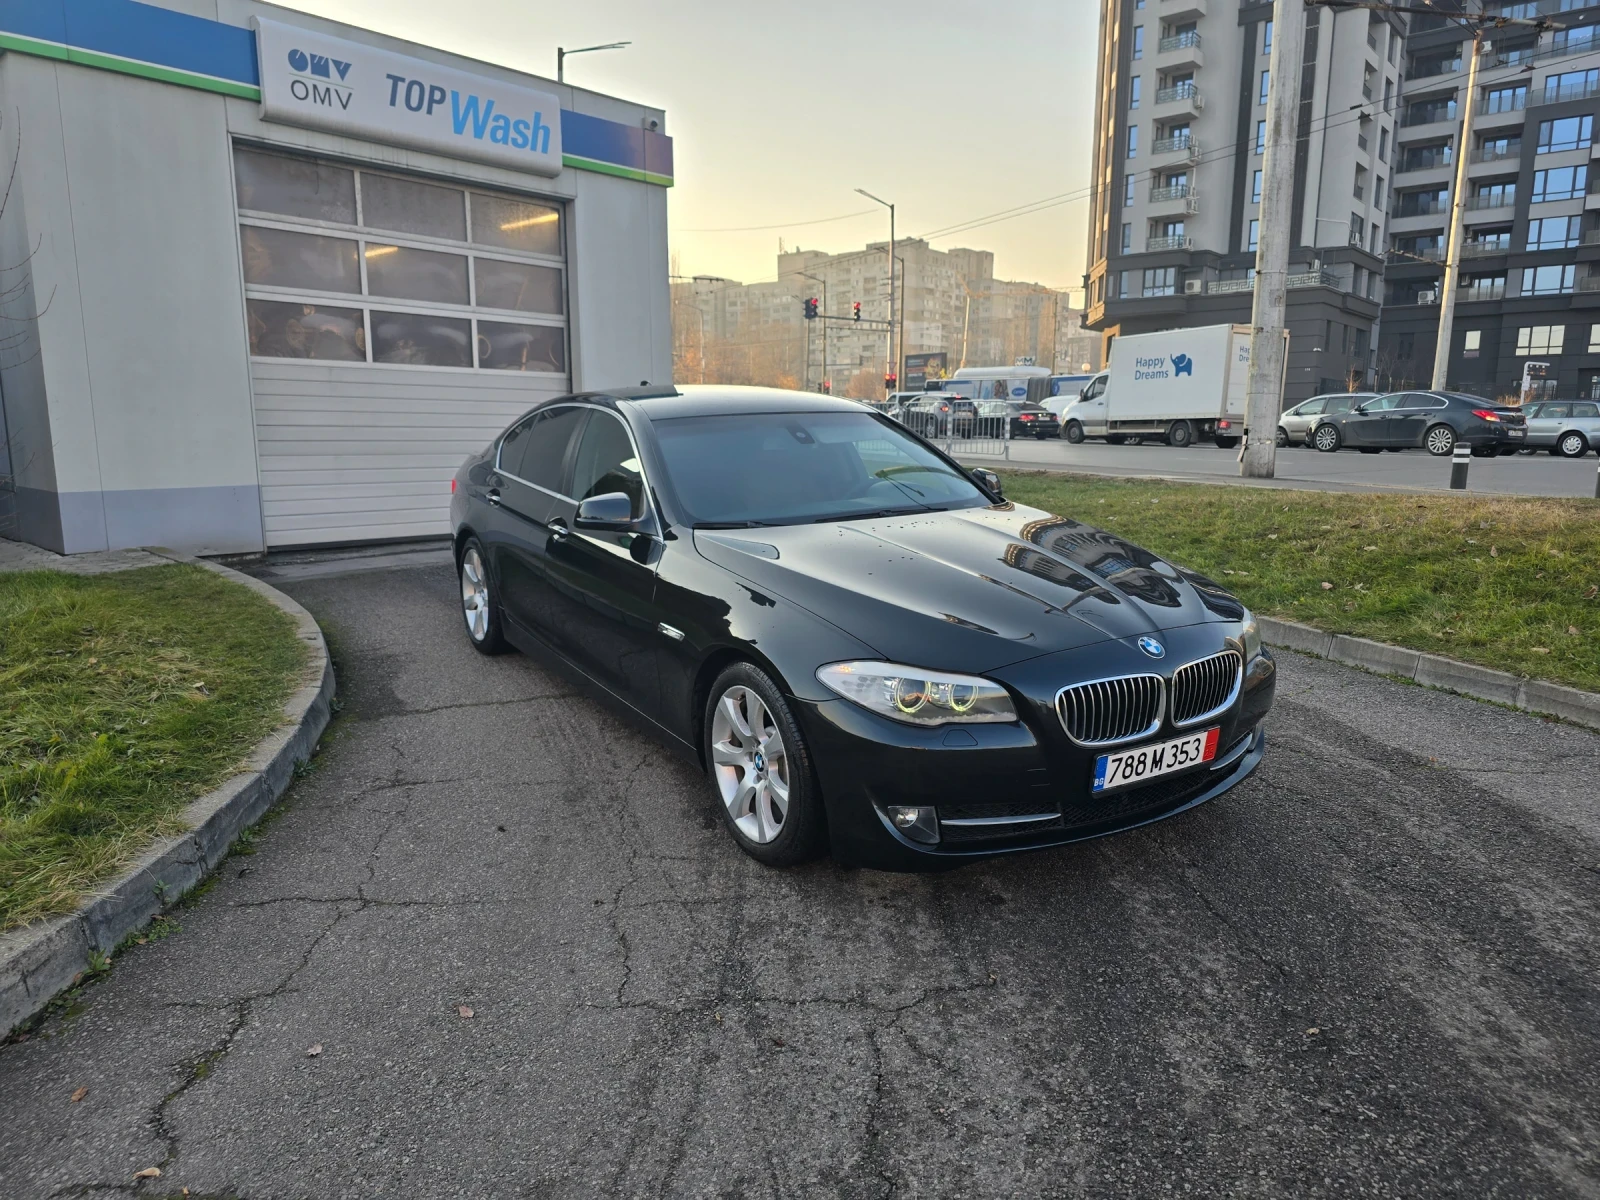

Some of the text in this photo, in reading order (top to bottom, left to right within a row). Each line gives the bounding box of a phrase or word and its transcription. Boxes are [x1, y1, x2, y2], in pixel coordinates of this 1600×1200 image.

[291, 80, 353, 110] OMV
[386, 73, 550, 154] TOP Wash
[1239, 345, 1251, 355] Hap
[1135, 357, 1165, 369] Happy
[1239, 354, 1250, 362] Dre
[1135, 370, 1169, 380] Dreams
[1108, 738, 1201, 784] 788 M 353
[1094, 777, 1104, 787] BG
